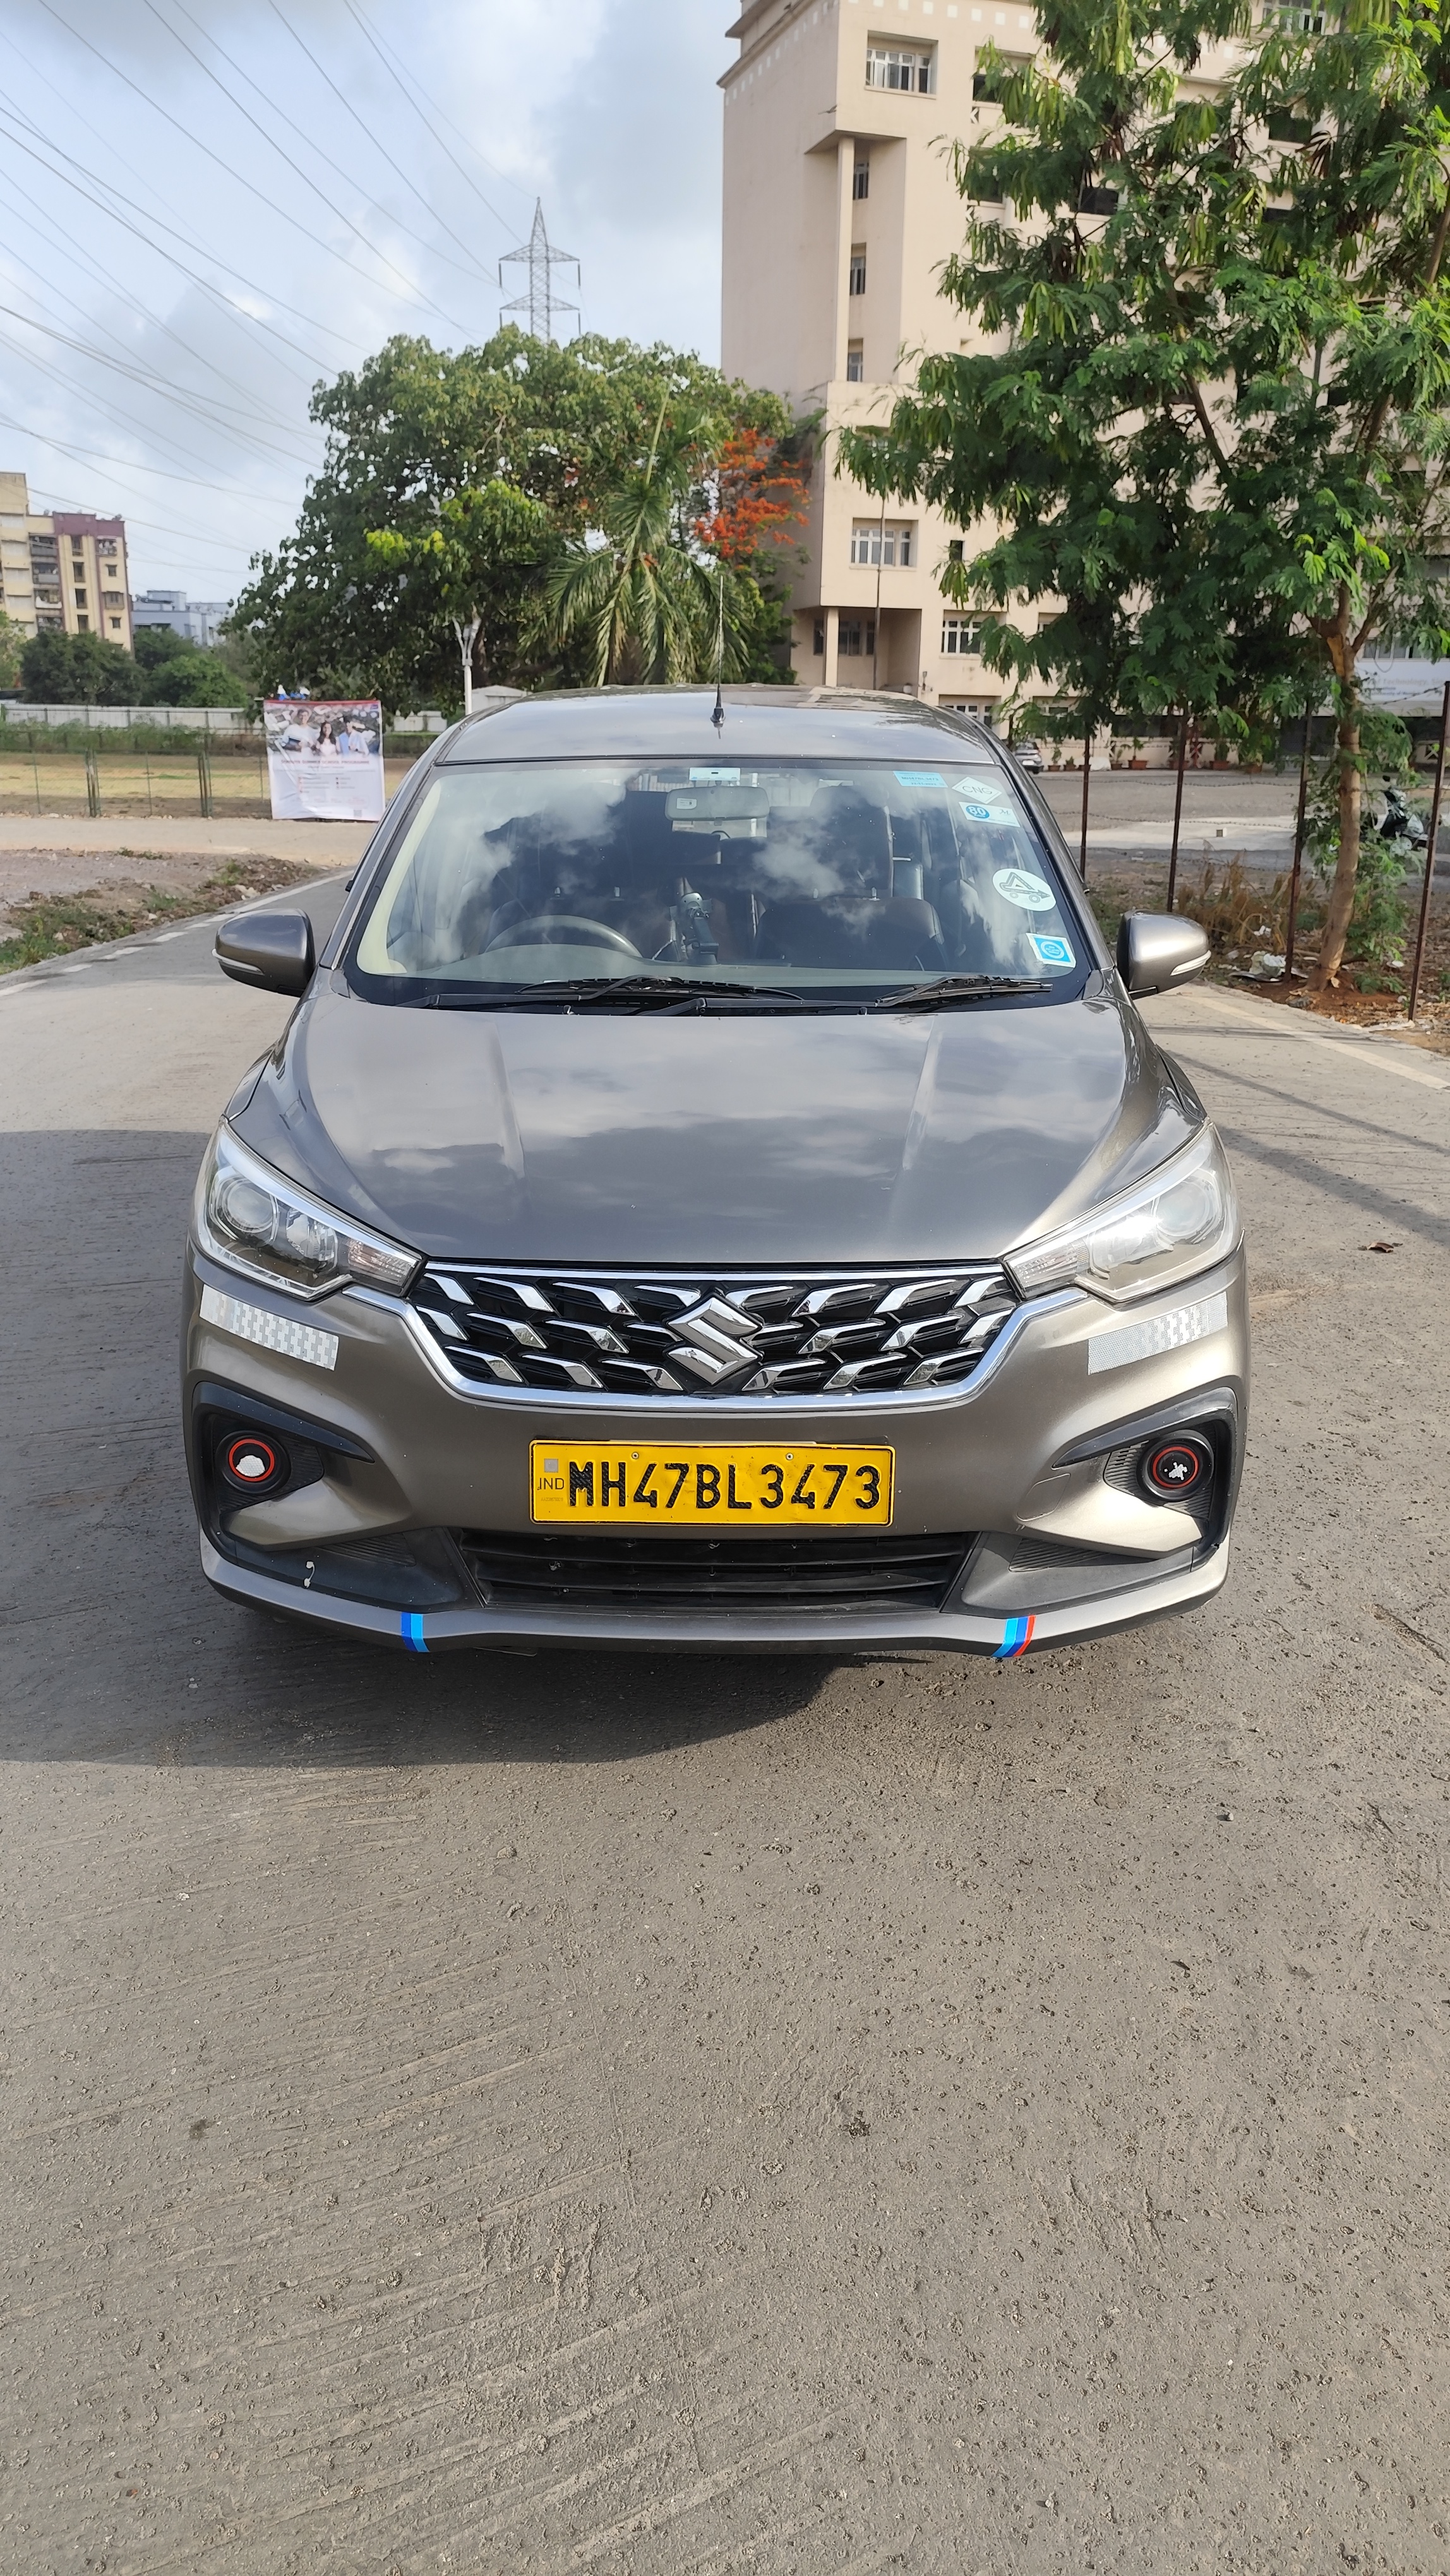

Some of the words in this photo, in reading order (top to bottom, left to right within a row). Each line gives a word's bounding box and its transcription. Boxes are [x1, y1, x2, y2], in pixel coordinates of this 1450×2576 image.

[962, 785, 993, 795] CNG
[968, 806, 986, 816] 80
[539, 1477, 565, 1490] IND
[568, 1460, 882, 1510] MH47BL3473
